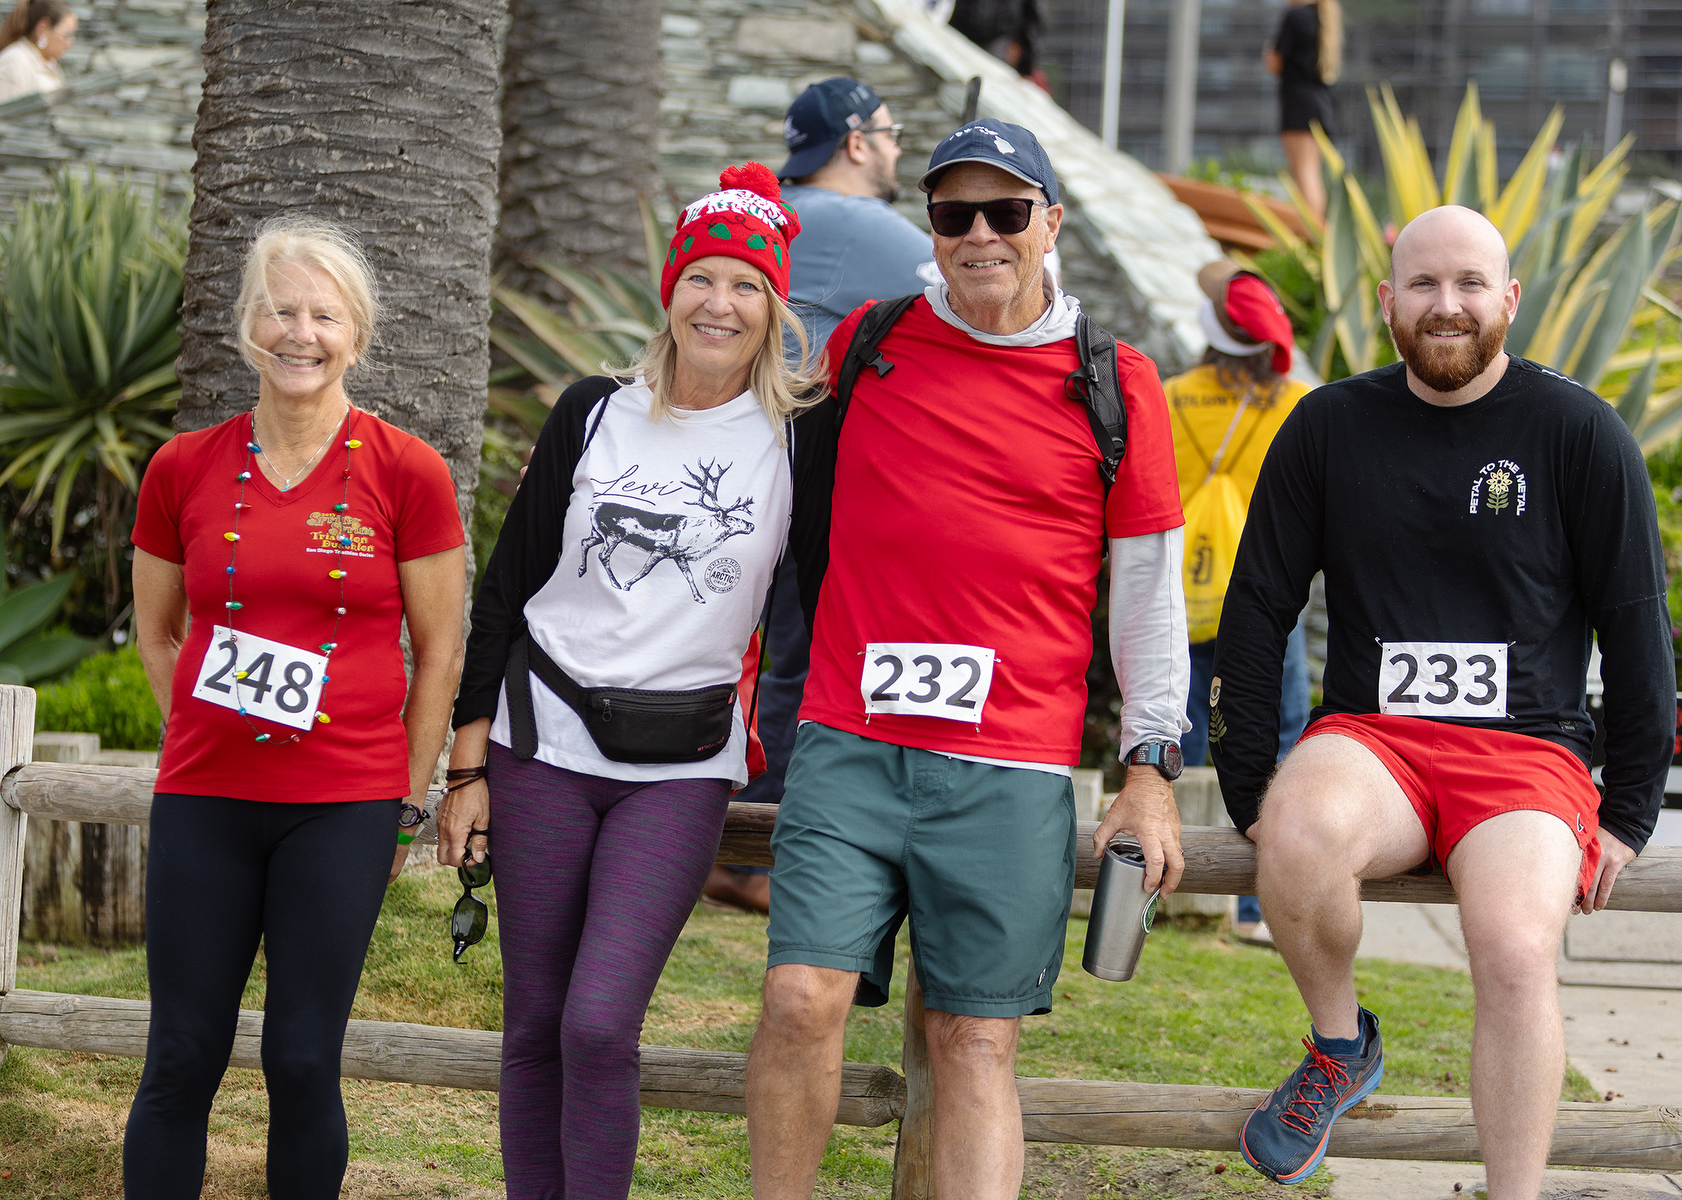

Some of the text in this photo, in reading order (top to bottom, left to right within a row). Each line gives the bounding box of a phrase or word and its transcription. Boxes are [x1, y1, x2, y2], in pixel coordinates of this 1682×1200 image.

[589, 464, 683, 506] Levi
[1469, 459, 1526, 516] PETAL TO THE METAL
[310, 531, 368, 543] Trialon
[710, 570, 735, 584] ARCTIC
[203, 640, 313, 723] 248
[870, 654, 981, 710] 232
[1386, 653, 1498, 706] 233
